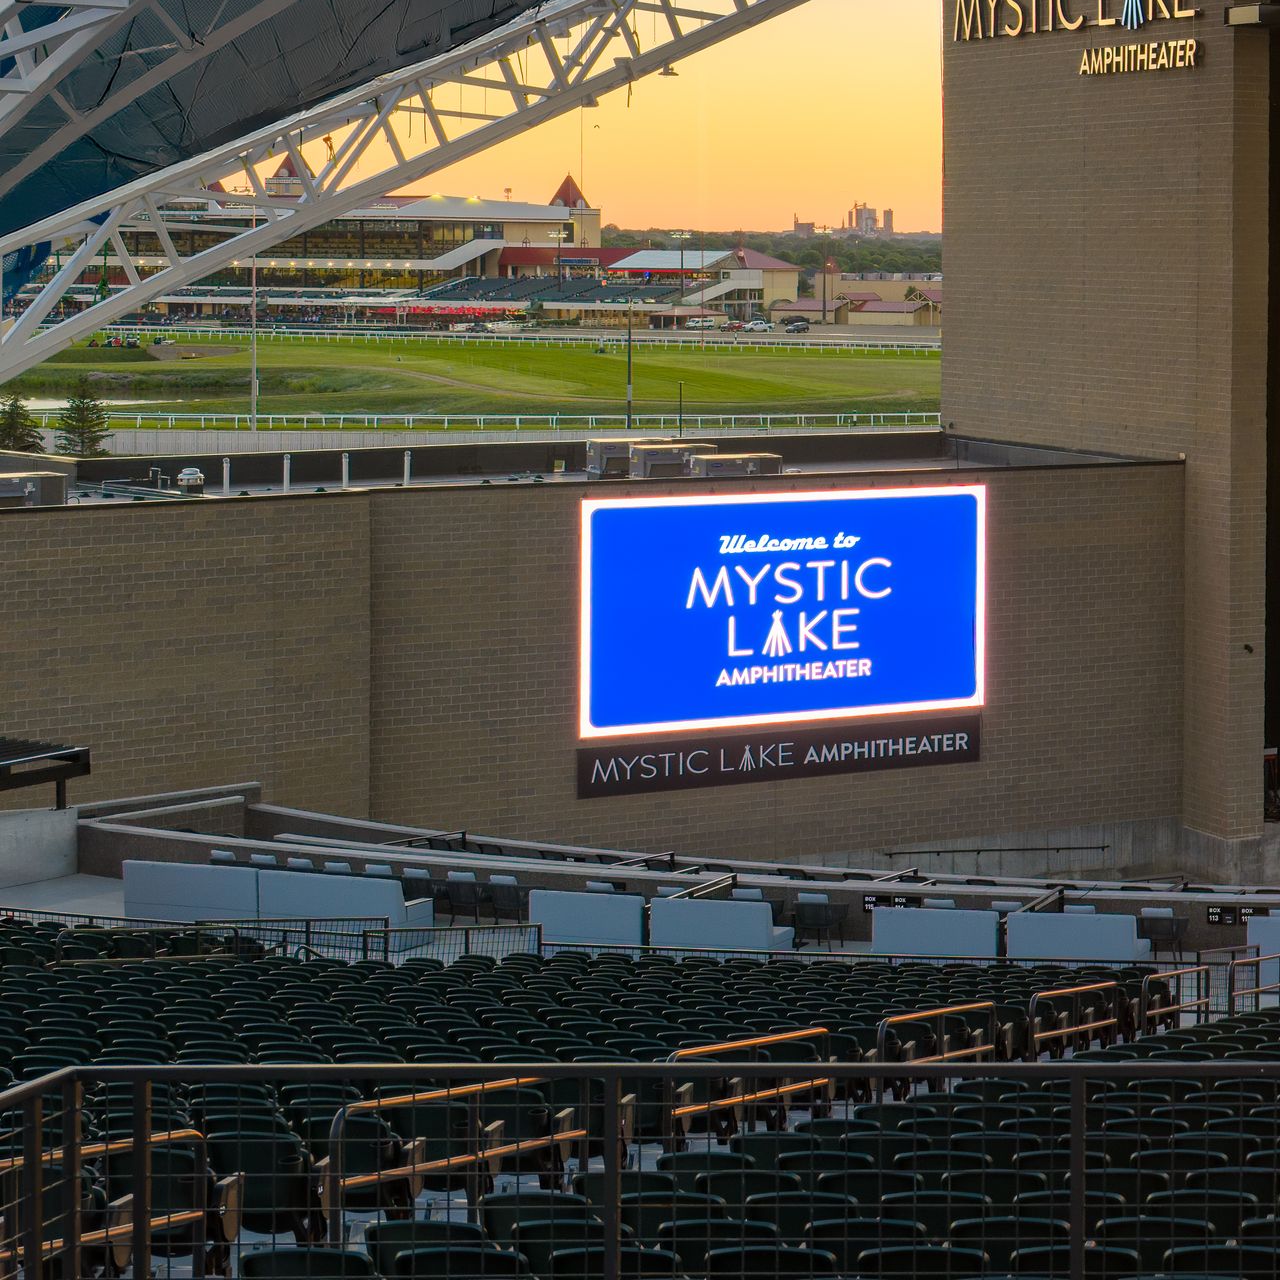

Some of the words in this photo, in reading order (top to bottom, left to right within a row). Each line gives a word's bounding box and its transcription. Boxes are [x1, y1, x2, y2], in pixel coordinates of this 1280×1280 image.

[1079, 38, 1198, 76] AMPHITHEATER
[719, 533, 829, 554] Welcome
[833, 531, 861, 549] to
[686, 557, 893, 609] MYSTIC
[728, 608, 861, 657] LAKE
[716, 658, 872, 687] AMPHITHEATER
[590, 749, 710, 784] MYSTIC
[720, 741, 795, 773] LAKE
[803, 732, 969, 766] AMPHITHEATER
